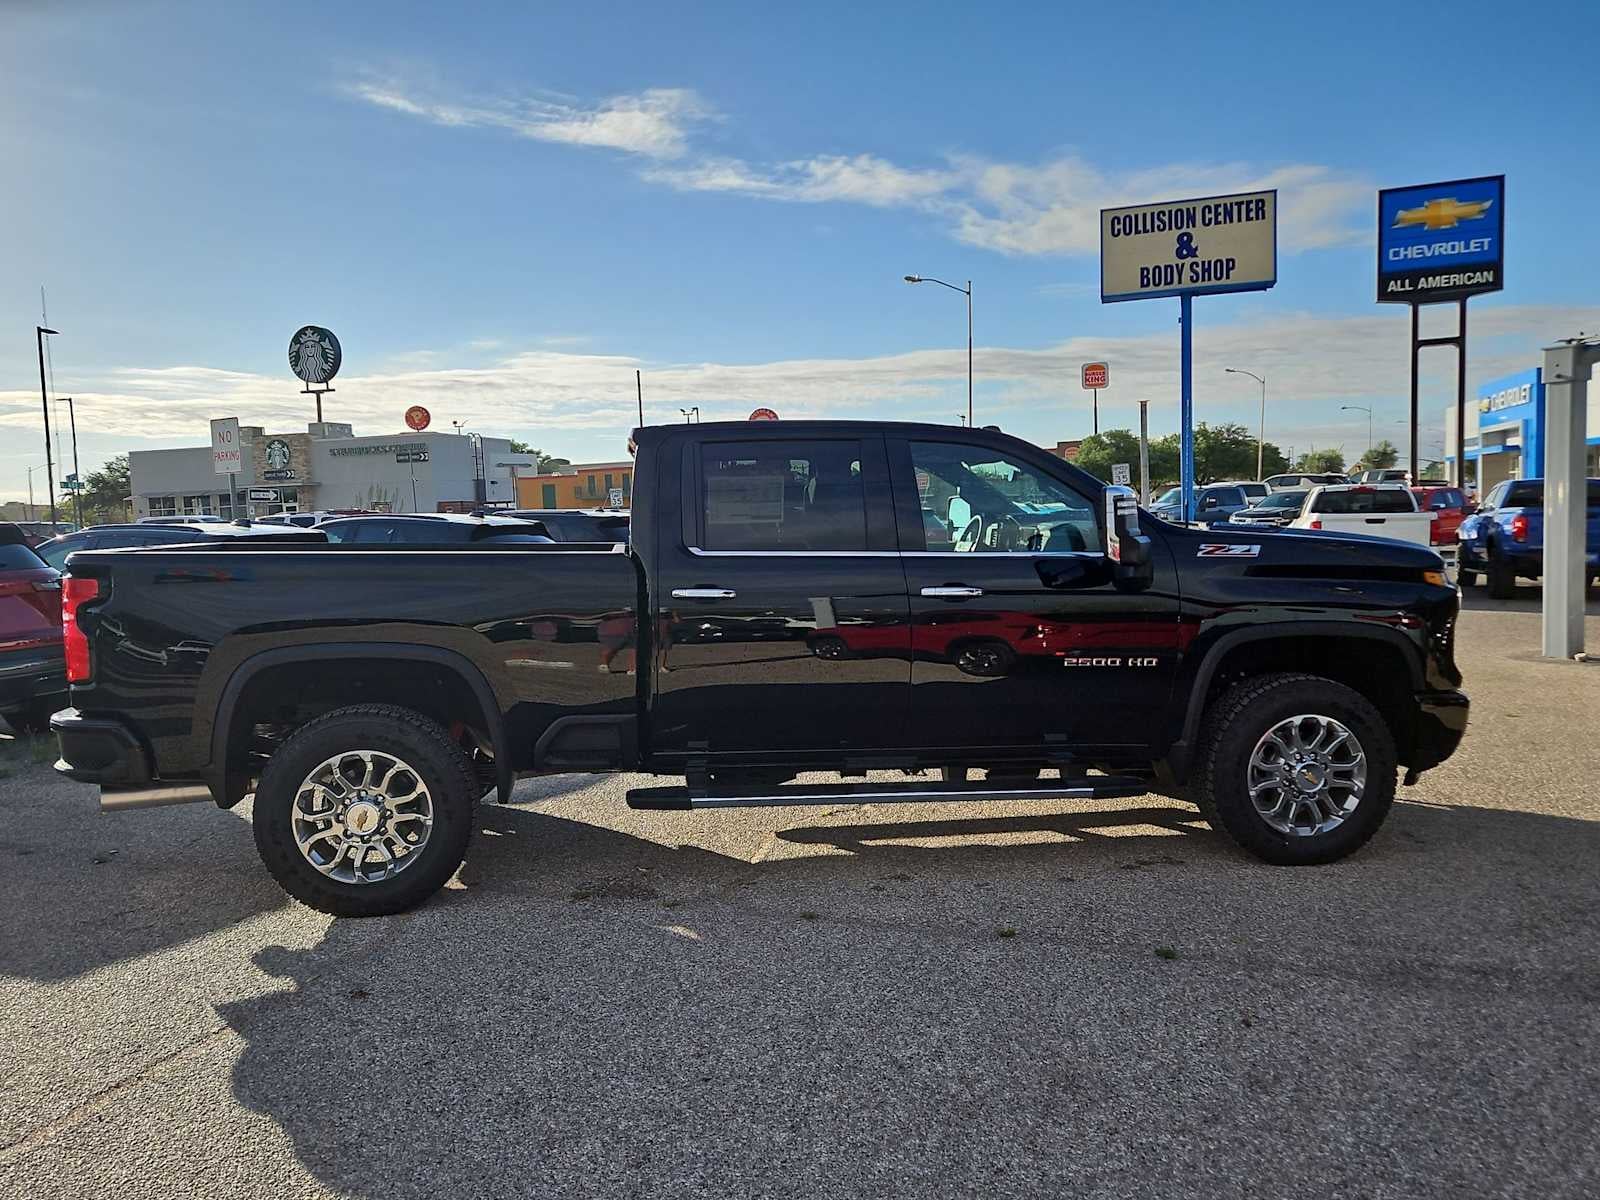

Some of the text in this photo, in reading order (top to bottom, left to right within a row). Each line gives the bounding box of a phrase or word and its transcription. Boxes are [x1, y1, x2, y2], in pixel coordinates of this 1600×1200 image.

[1110, 199, 1266, 238] COLLISION CENTER
[1175, 232, 1199, 260] &
[1388, 237, 1492, 261] CHEVROLET
[1139, 257, 1237, 288] BODY SHOP
[1387, 270, 1495, 292] ALL AMERICAN
[218, 430, 232, 444] NO
[214, 450, 240, 461] PARKING
[1115, 475, 1128, 483] 35
[612, 497, 622, 506] 35
[1063, 657, 1158, 667] 2500 HD
